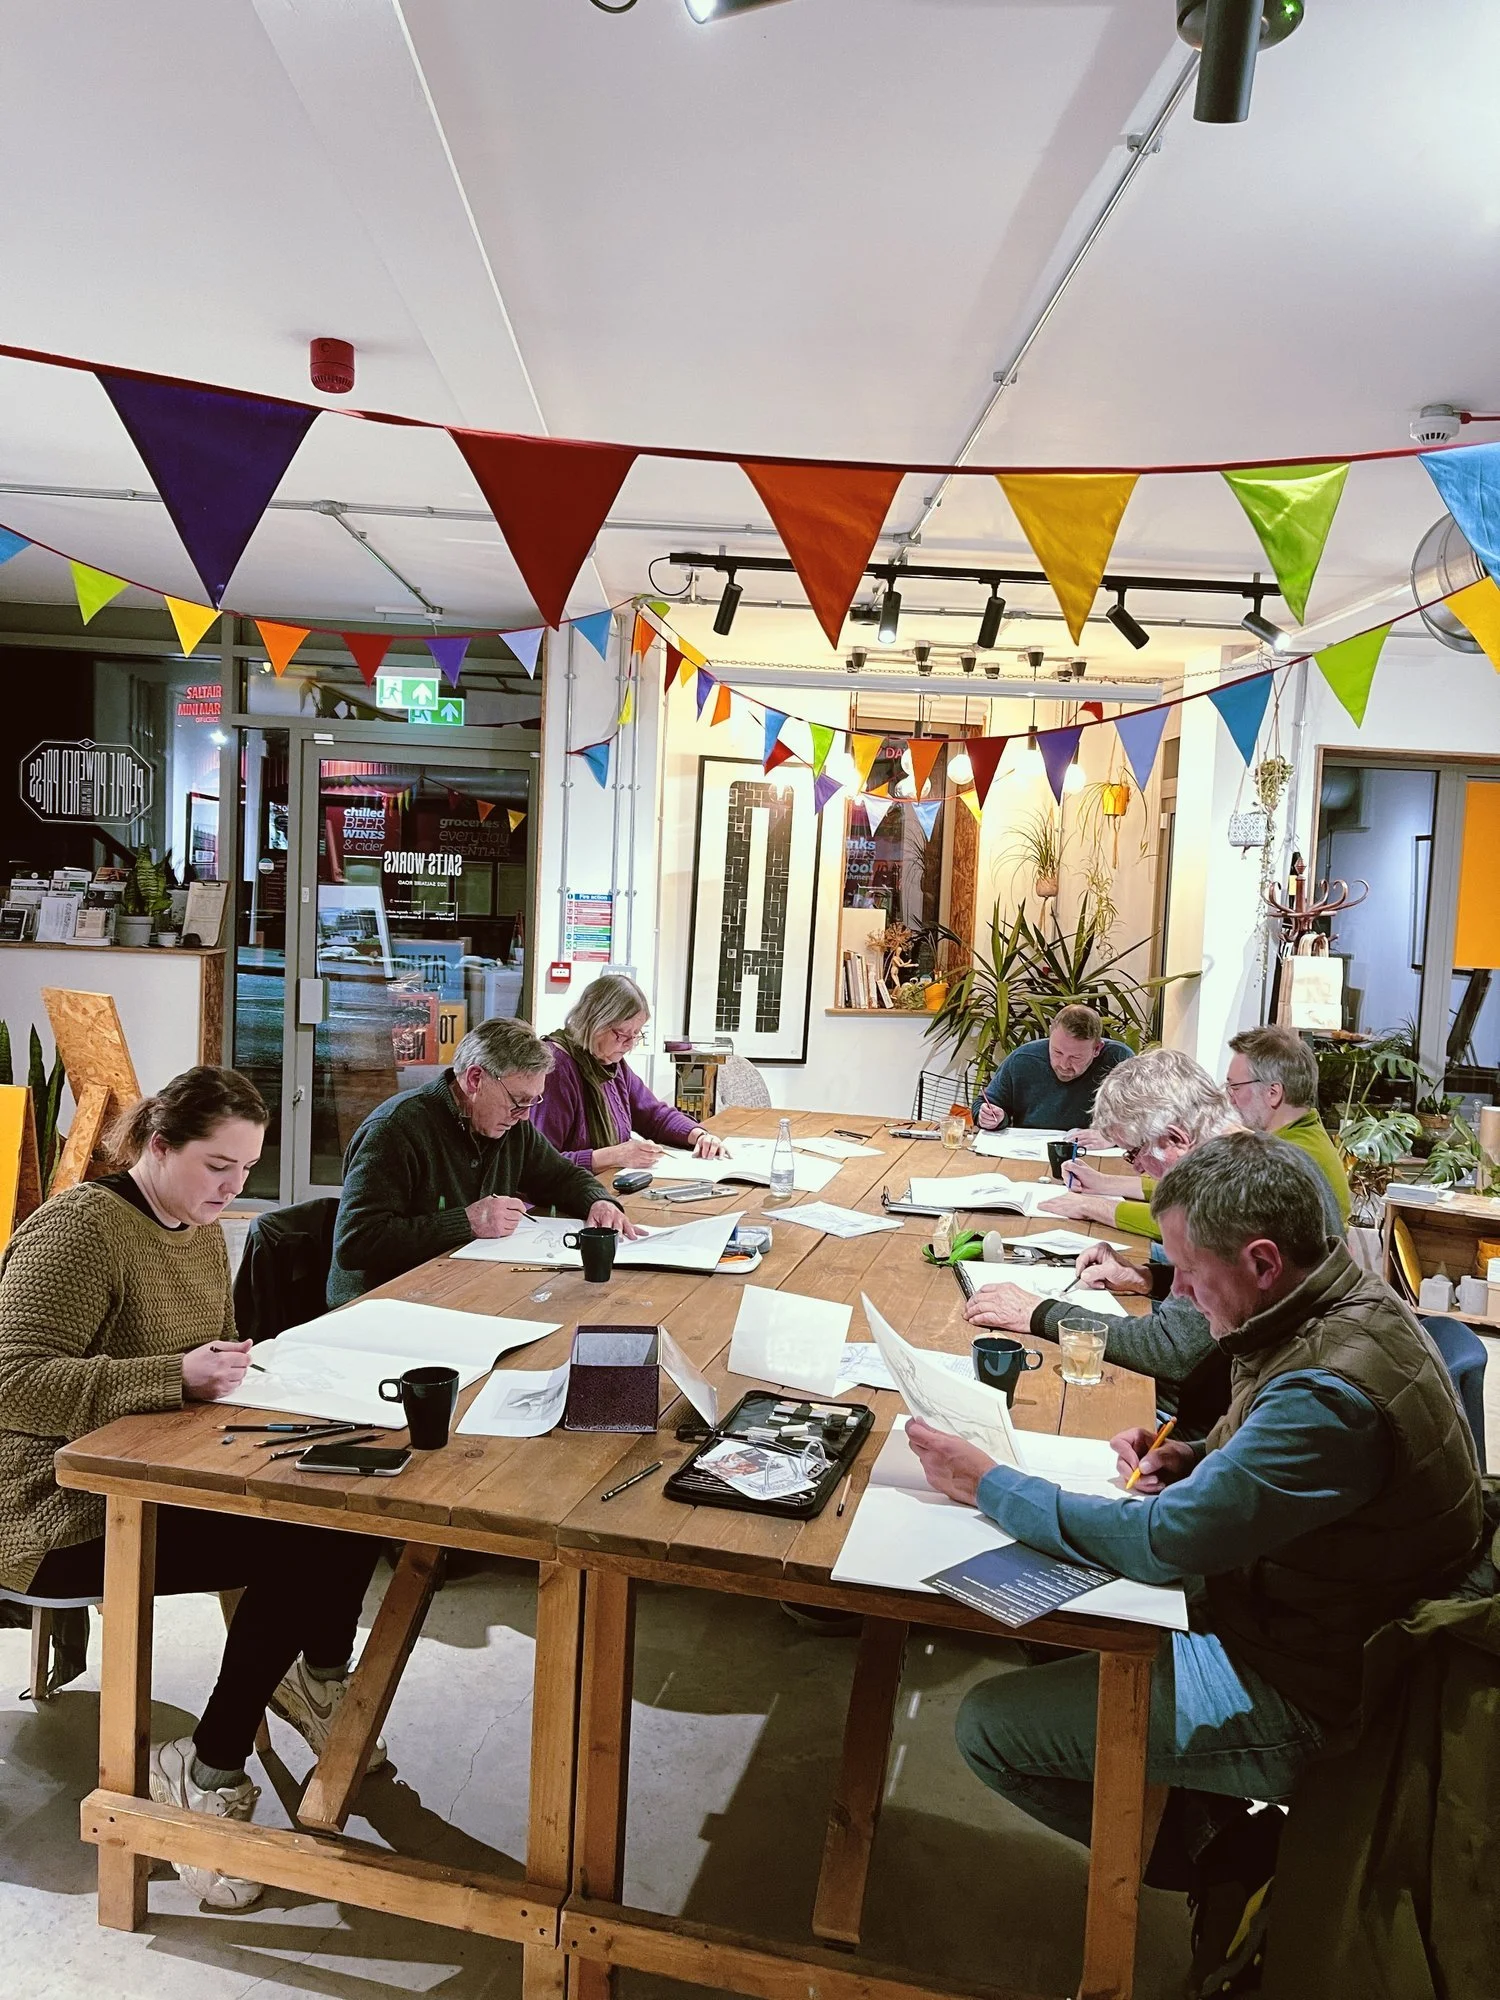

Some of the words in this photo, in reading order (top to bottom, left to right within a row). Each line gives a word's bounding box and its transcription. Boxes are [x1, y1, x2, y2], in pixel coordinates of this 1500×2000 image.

[177, 703, 199, 716] MINI
[343, 807, 386, 818] chilled
[343, 817, 386, 831] BEER
[343, 830, 386, 840] WINES
[343, 839, 353, 850] &
[355, 840, 384, 851] cider
